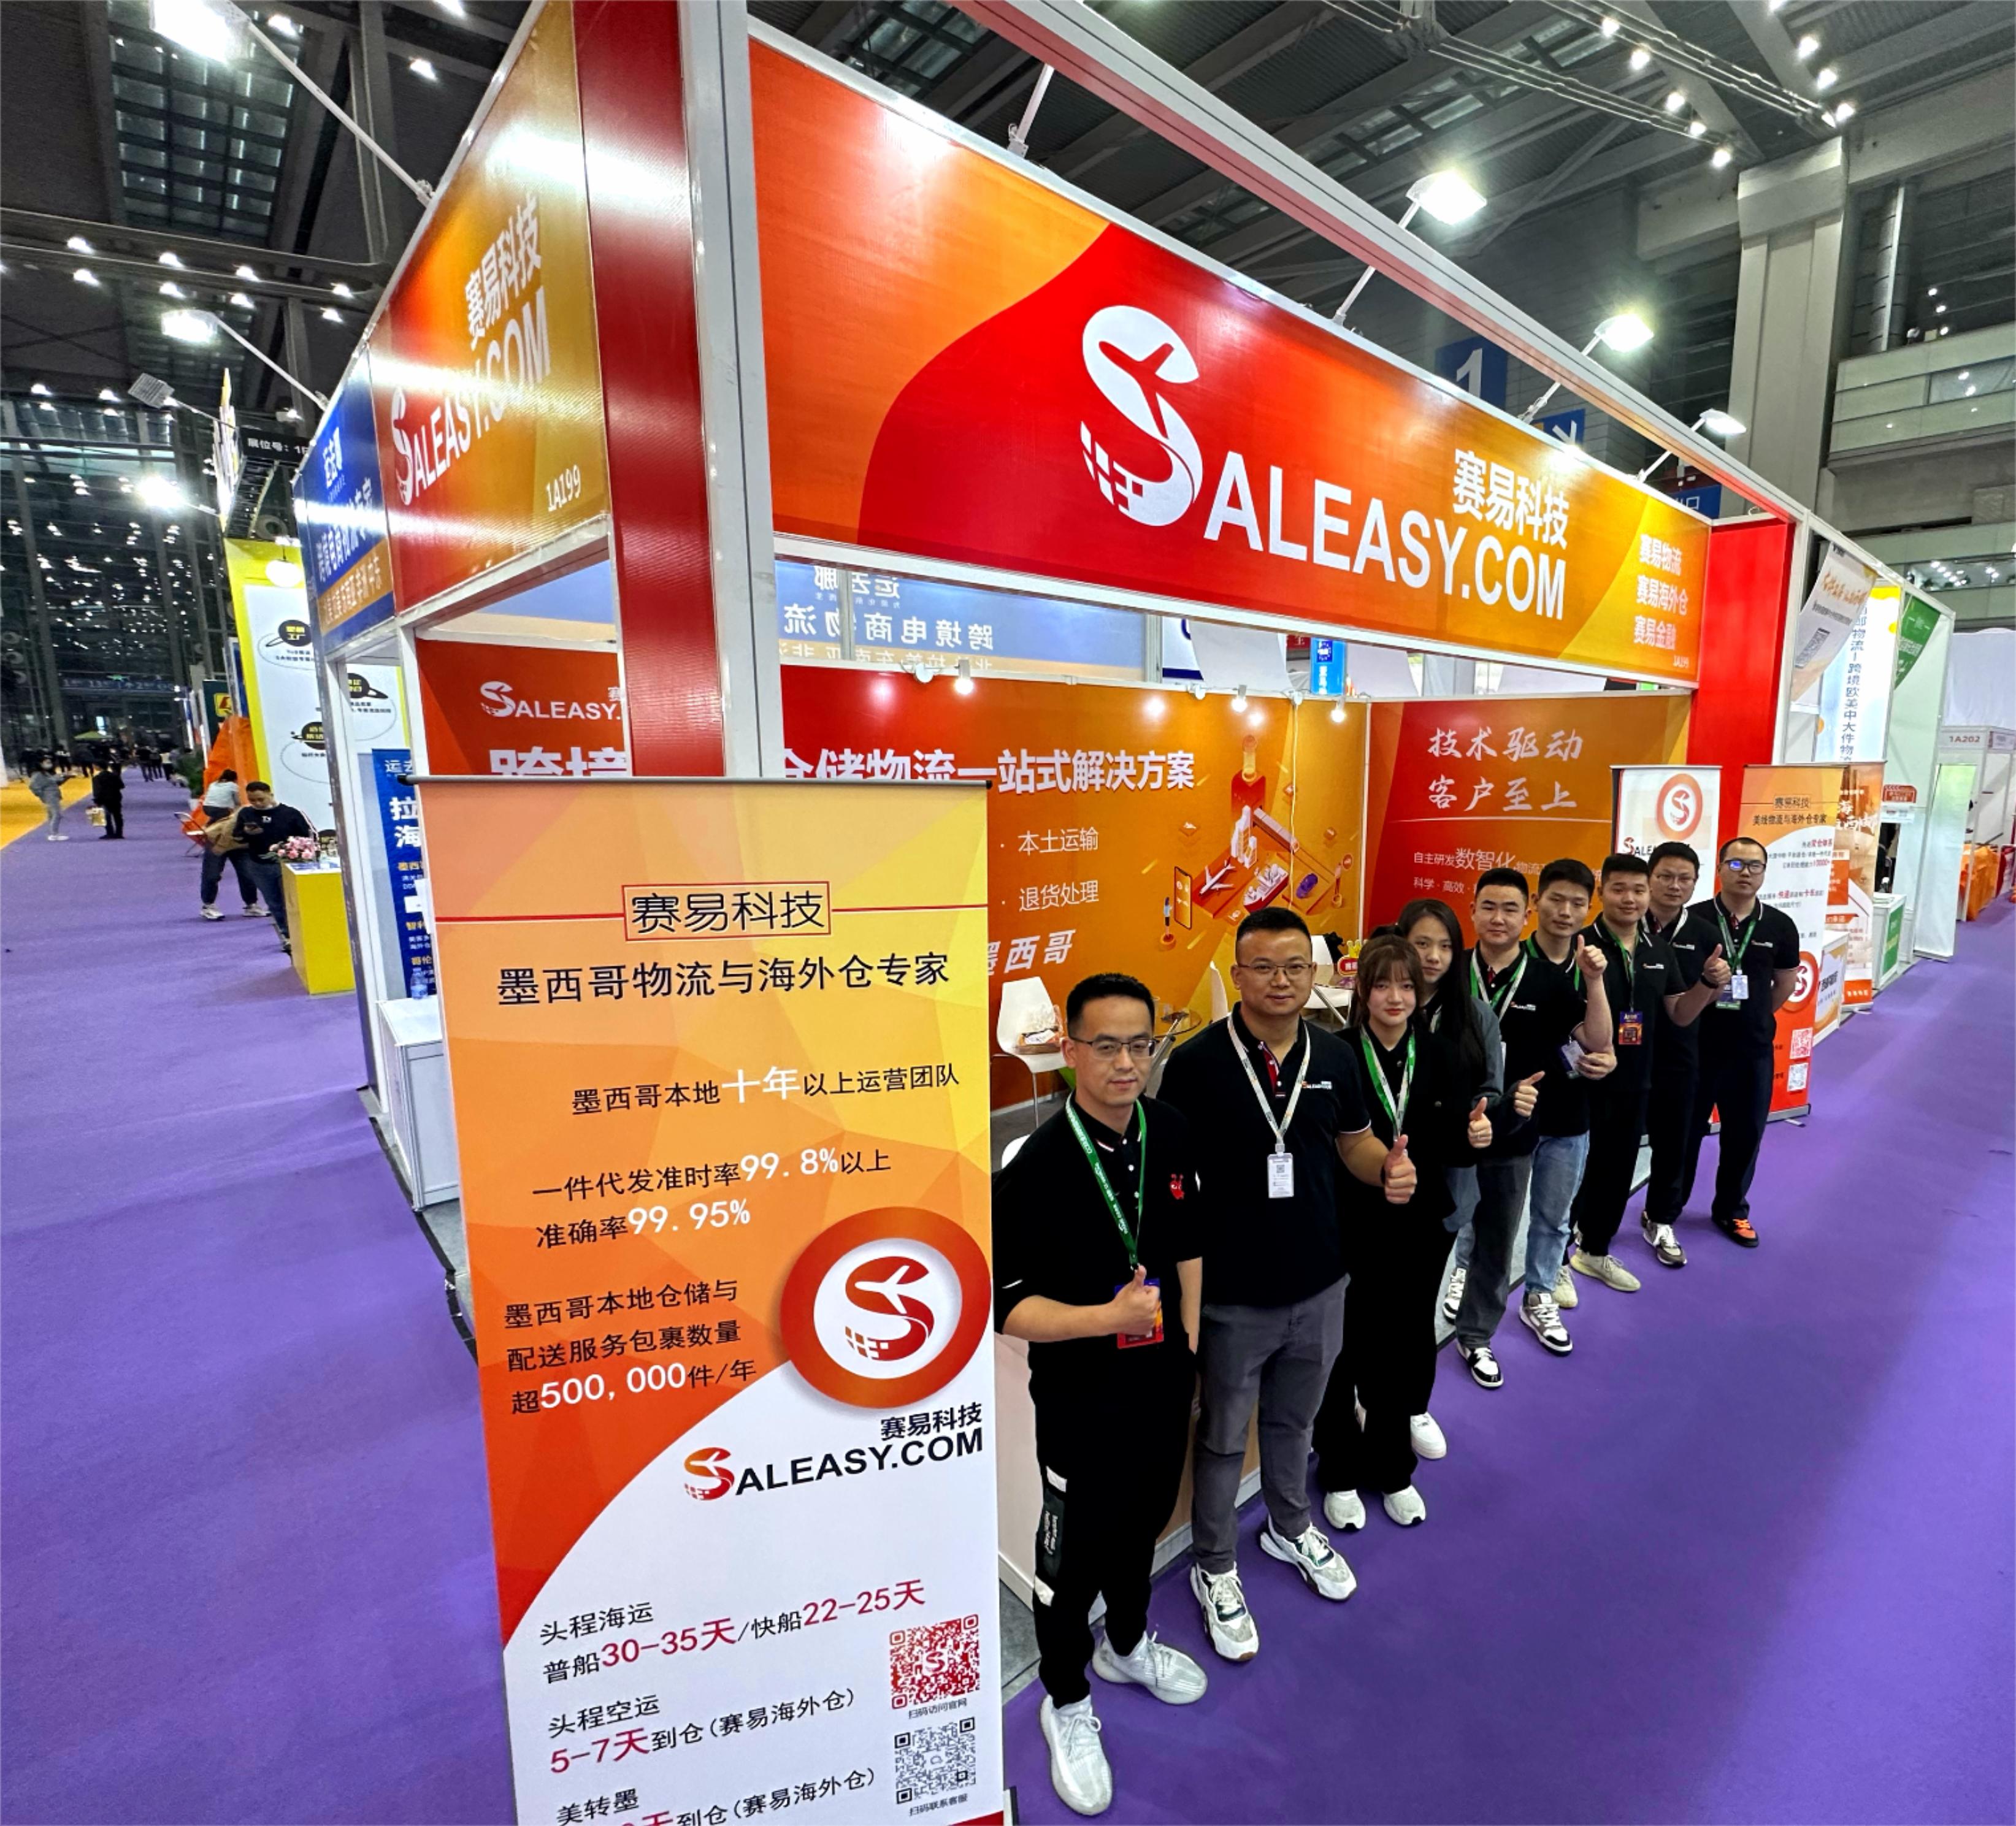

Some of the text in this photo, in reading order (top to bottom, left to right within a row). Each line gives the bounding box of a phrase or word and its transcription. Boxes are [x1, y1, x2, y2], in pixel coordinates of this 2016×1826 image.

[464, 191, 542, 350] 赛易科技
[1082, 305, 1566, 621] SALEASY.COM
[545, 464, 581, 512] 1A199
[1453, 448, 1570, 551] 赛易科技
[1675, 495, 1700, 511] 口
[1638, 533, 1682, 576] 赛易物流
[1636, 575, 1688, 616] 赛易海外仓
[1633, 615, 1677, 651] 赛易金融
[1427, 727, 1584, 762] 技术驱动
[1428, 774, 1578, 811] 客户至上
[1018, 827, 1099, 856] 本土运输
[1019, 881, 1099, 913] 退货处理
[1413, 877, 1435, 889] 科学
[631, 889, 826, 934] 赛易科技
[497, 952, 950, 1007] 墨西哥物流与海外仓专家
[572, 1063, 960, 1115] 墨西哥本地十年以上运营团队
[504, 1278, 738, 1329] 墨西哥本地仓储与
[507, 1320, 741, 1373] 配送服务包裹数量
[880, 1402, 983, 1440] 赛易科技
[683, 1427, 983, 1502] SALEASY.COM
[539, 1601, 654, 1647] 头程海运
[548, 1694, 660, 1739] 头程空运
[908, 1698, 968, 1719] 扫码访问官网
[556, 1787, 639, 1826] 美转墨
[909, 1793, 968, 1816] 扫码联系客服
